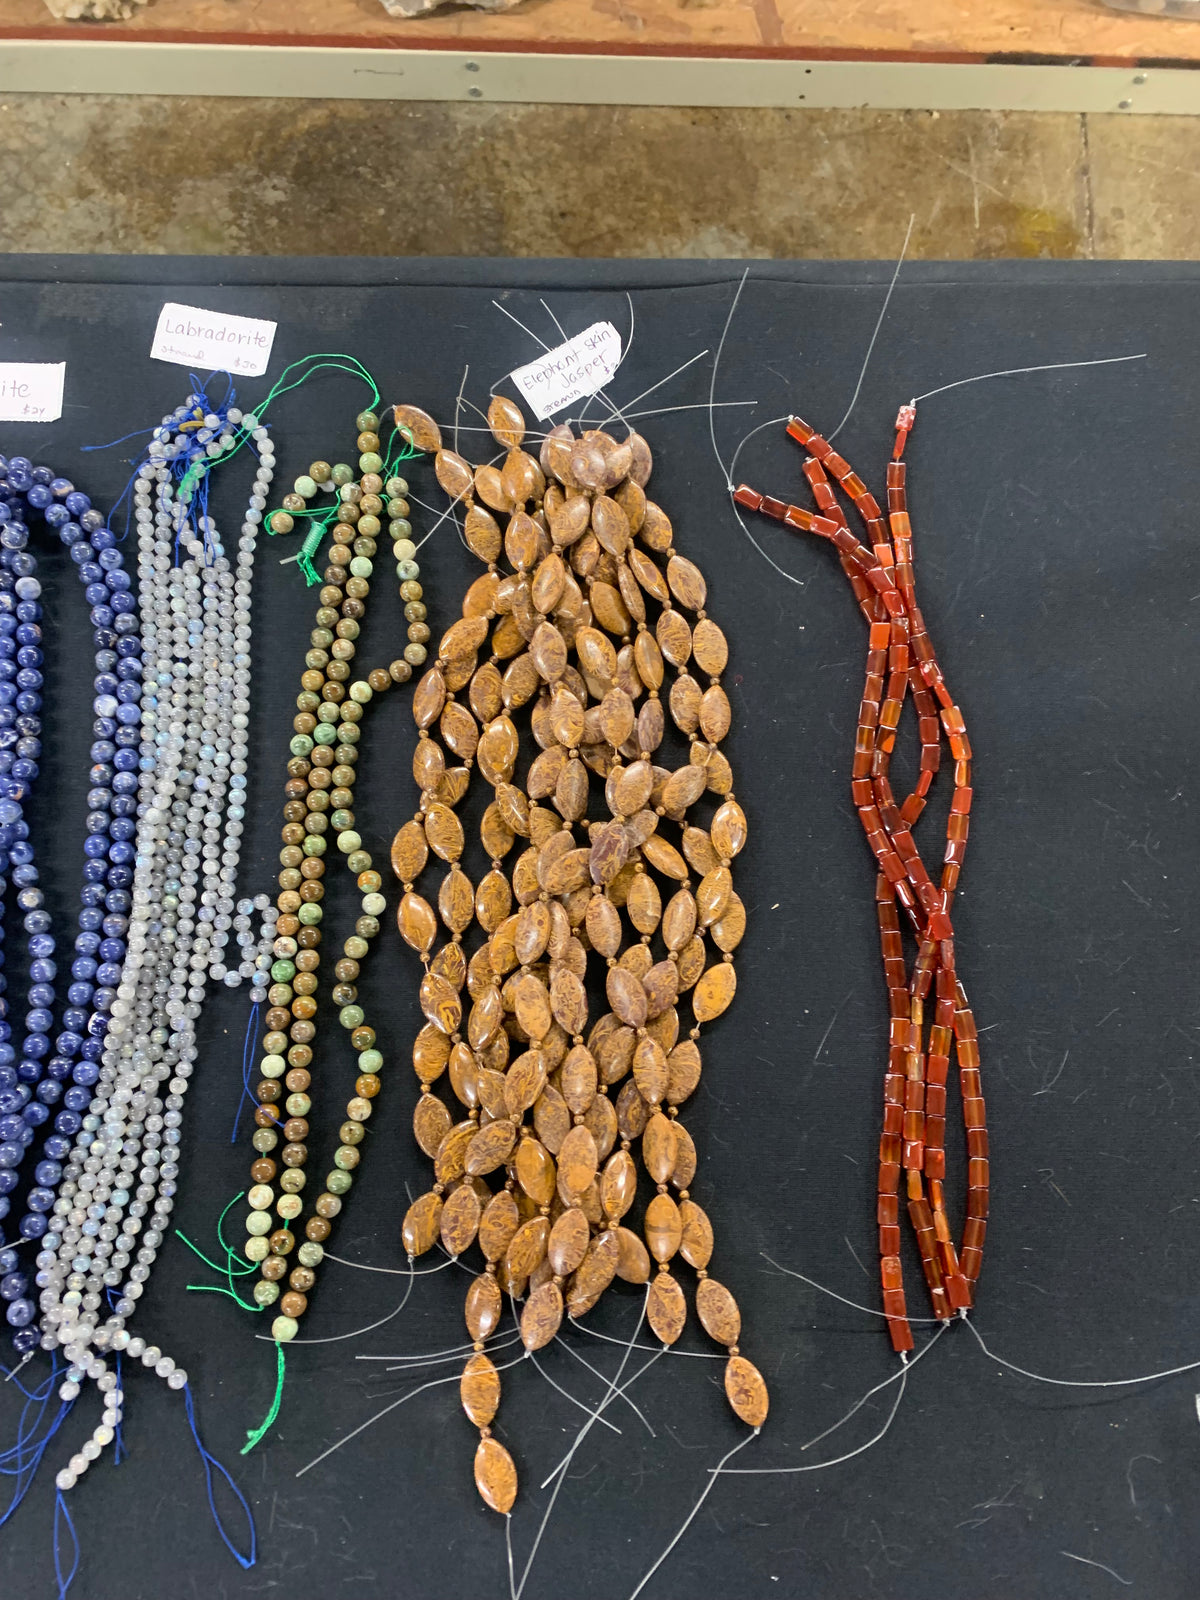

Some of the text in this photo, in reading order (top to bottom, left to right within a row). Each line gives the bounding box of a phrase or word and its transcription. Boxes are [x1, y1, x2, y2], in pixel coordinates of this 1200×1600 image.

[165, 319, 269, 348] Labradorite
[523, 349, 582, 391] Elephant
[561, 349, 607, 389] Jasper
